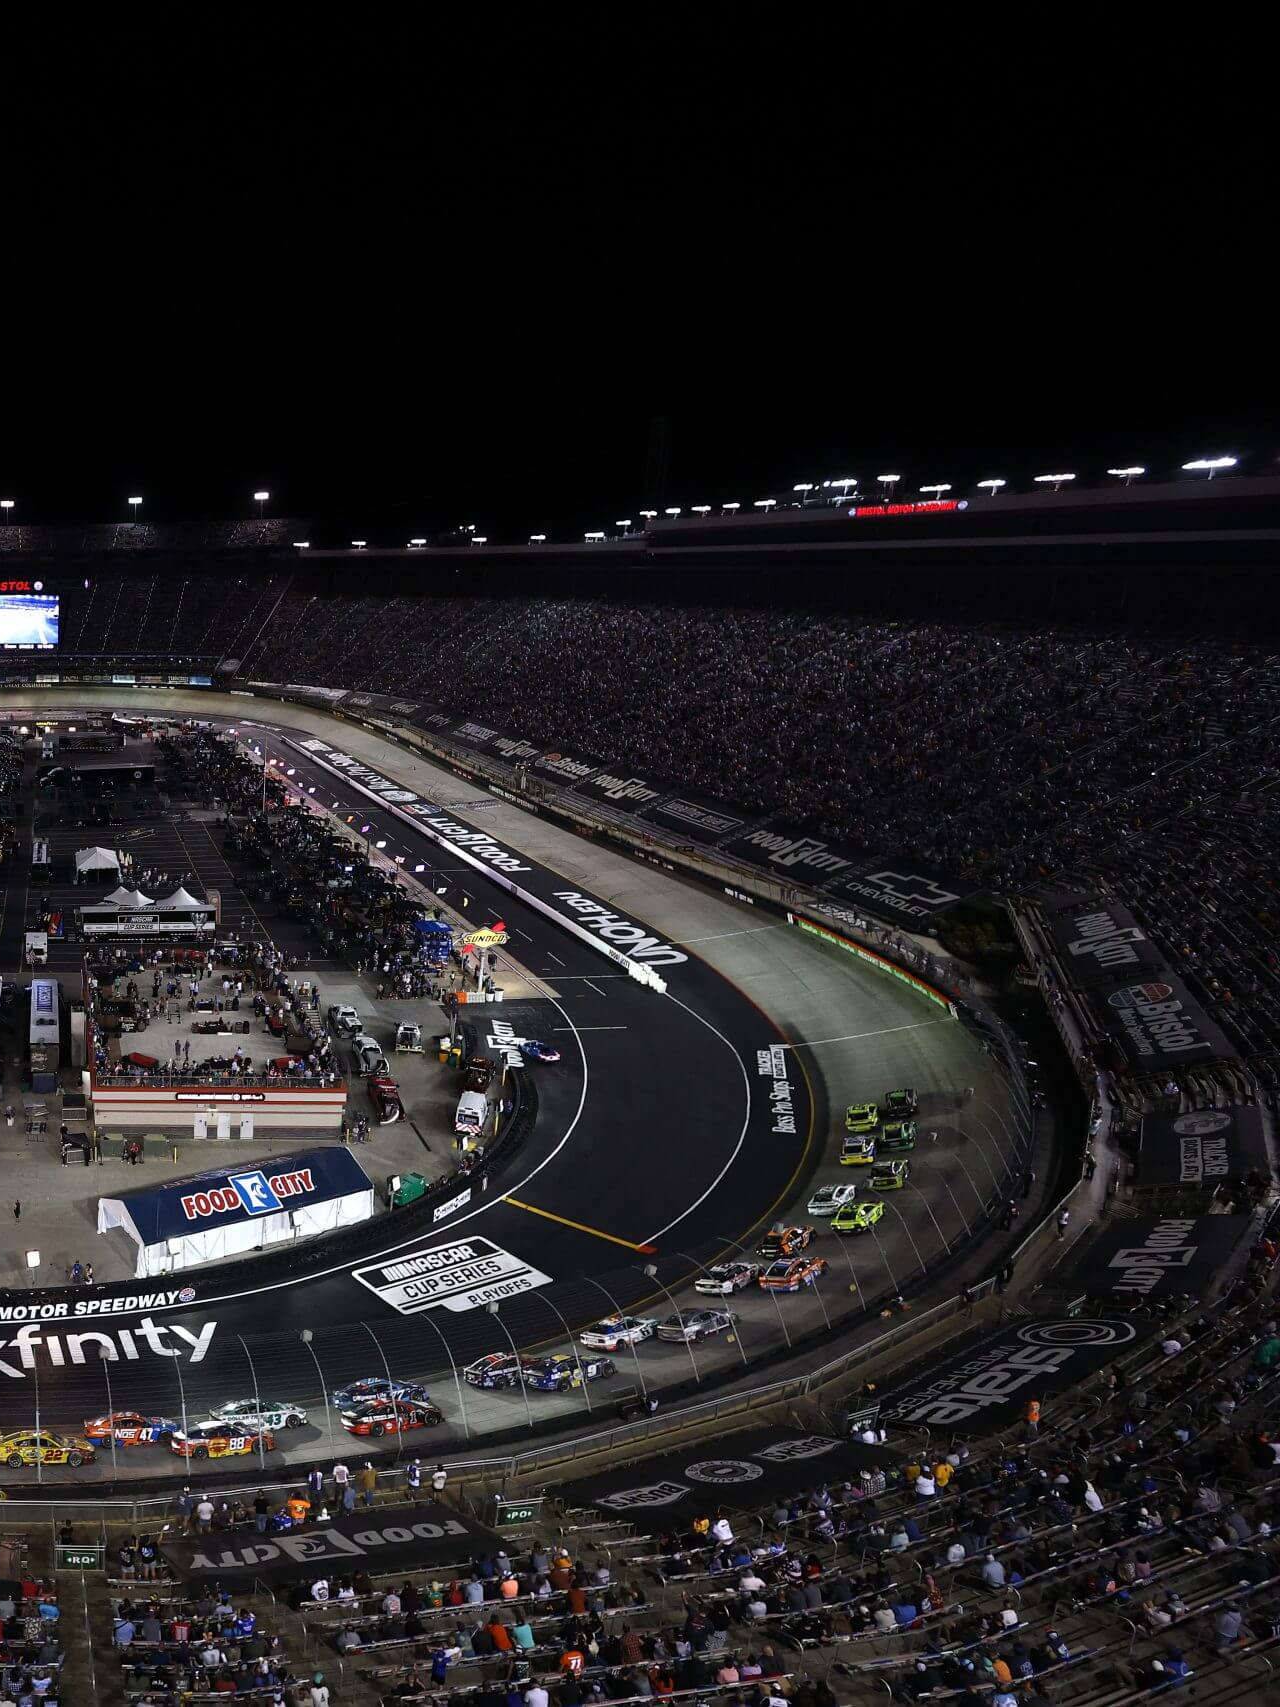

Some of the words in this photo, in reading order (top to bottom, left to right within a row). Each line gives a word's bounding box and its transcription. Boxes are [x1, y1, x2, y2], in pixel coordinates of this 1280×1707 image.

[553, 757, 598, 776] Bristol
[590, 774, 624, 789] FOOD
[626, 787, 660, 801] CITY
[427, 817, 473, 841] CITY
[470, 846, 533, 873] FOOD
[744, 829, 793, 851] FOOD
[803, 852, 853, 872] CITY
[845, 882, 933, 917] CHEVROLET
[1072, 911, 1117, 937] FOOD
[465, 935, 505, 943] SUNOCO
[1091, 943, 1140, 967] CITY
[491, 1019, 516, 1037] CITY
[1135, 1000, 1211, 1053] Bristol
[757, 1050, 773, 1076] TRACKER
[769, 1080, 795, 1102] Shops
[771, 1101, 794, 1115] Pro
[771, 1115, 796, 1134] Bass
[1202, 1138, 1230, 1176] TRACKER
[181, 1187, 241, 1219] FOOD
[269, 1168, 315, 1197] CITY
[1144, 1219, 1197, 1248] FOOD
[380, 1244, 478, 1281] NASCAR
[403, 1279, 440, 1299] CUP
[443, 1260, 502, 1288] SERIES
[1111, 1267, 1166, 1295] CITY
[74, 1290, 180, 1315] SPEEDWAY
[467, 1279, 532, 1306] PLAYOFFS
[587, 1366, 597, 1377] 9
[901, 1342, 1069, 1423] state
[265, 1413, 281, 1427] 43
[115, 1428, 138, 1438] NOS
[139, 1428, 153, 1441] 47
[229, 1436, 245, 1450] 88
[45, 1449, 62, 1460] 22
[762, 1437, 833, 1460] BUSH'S
[605, 1483, 683, 1508] BUSH'S
[511, 1510, 526, 1519] PO
[353, 1520, 472, 1546] FOOD
[190, 1543, 280, 1569] CITY
